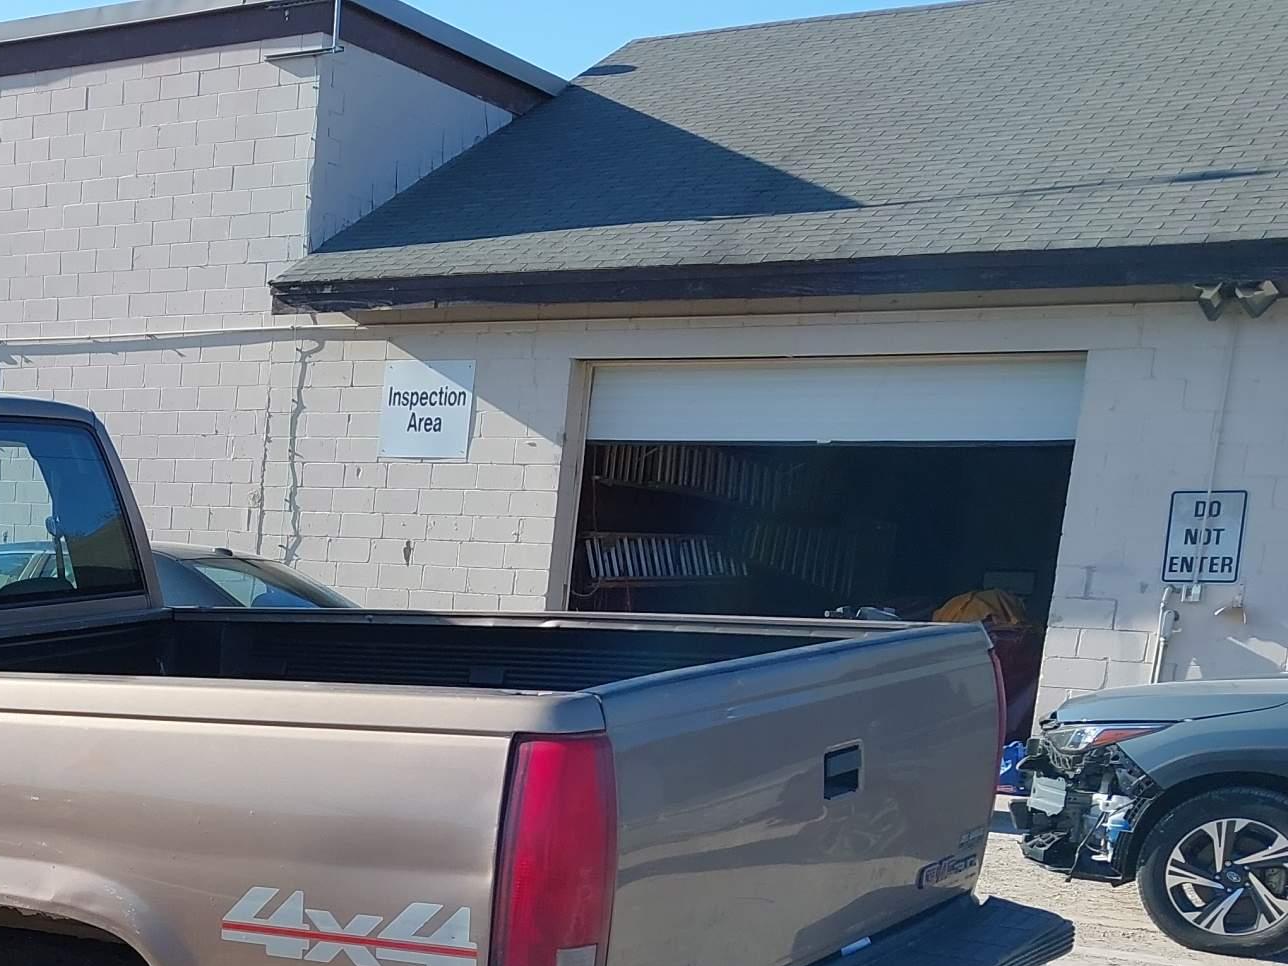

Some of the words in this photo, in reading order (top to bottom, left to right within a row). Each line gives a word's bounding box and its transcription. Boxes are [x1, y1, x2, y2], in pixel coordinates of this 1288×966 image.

[388, 386, 467, 411] Inspection
[407, 412, 442, 432] Area
[1194, 501, 1222, 518] DO
[1184, 528, 1225, 545] NOT
[1168, 556, 1234, 573] ENTER
